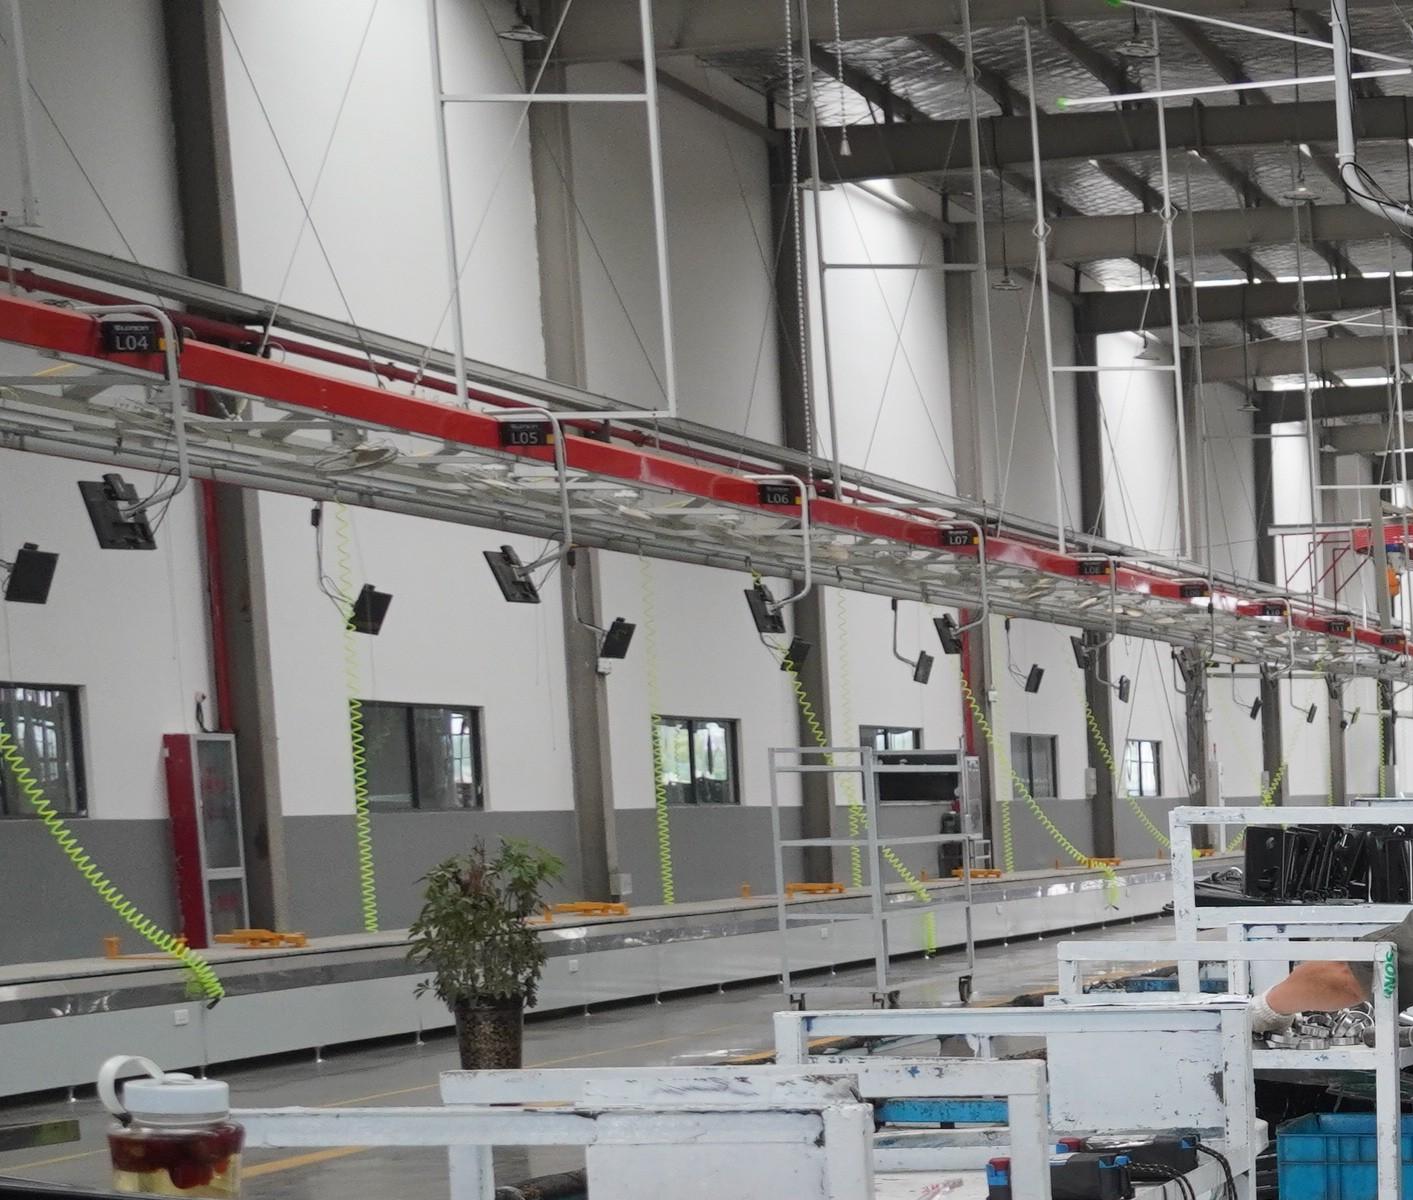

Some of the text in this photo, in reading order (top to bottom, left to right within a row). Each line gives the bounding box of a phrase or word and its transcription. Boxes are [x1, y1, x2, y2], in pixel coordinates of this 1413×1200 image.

[116, 335, 148, 350] L04
[512, 432, 537, 444] L05
[767, 493, 789, 504] L06
[949, 535, 968, 545] L07
